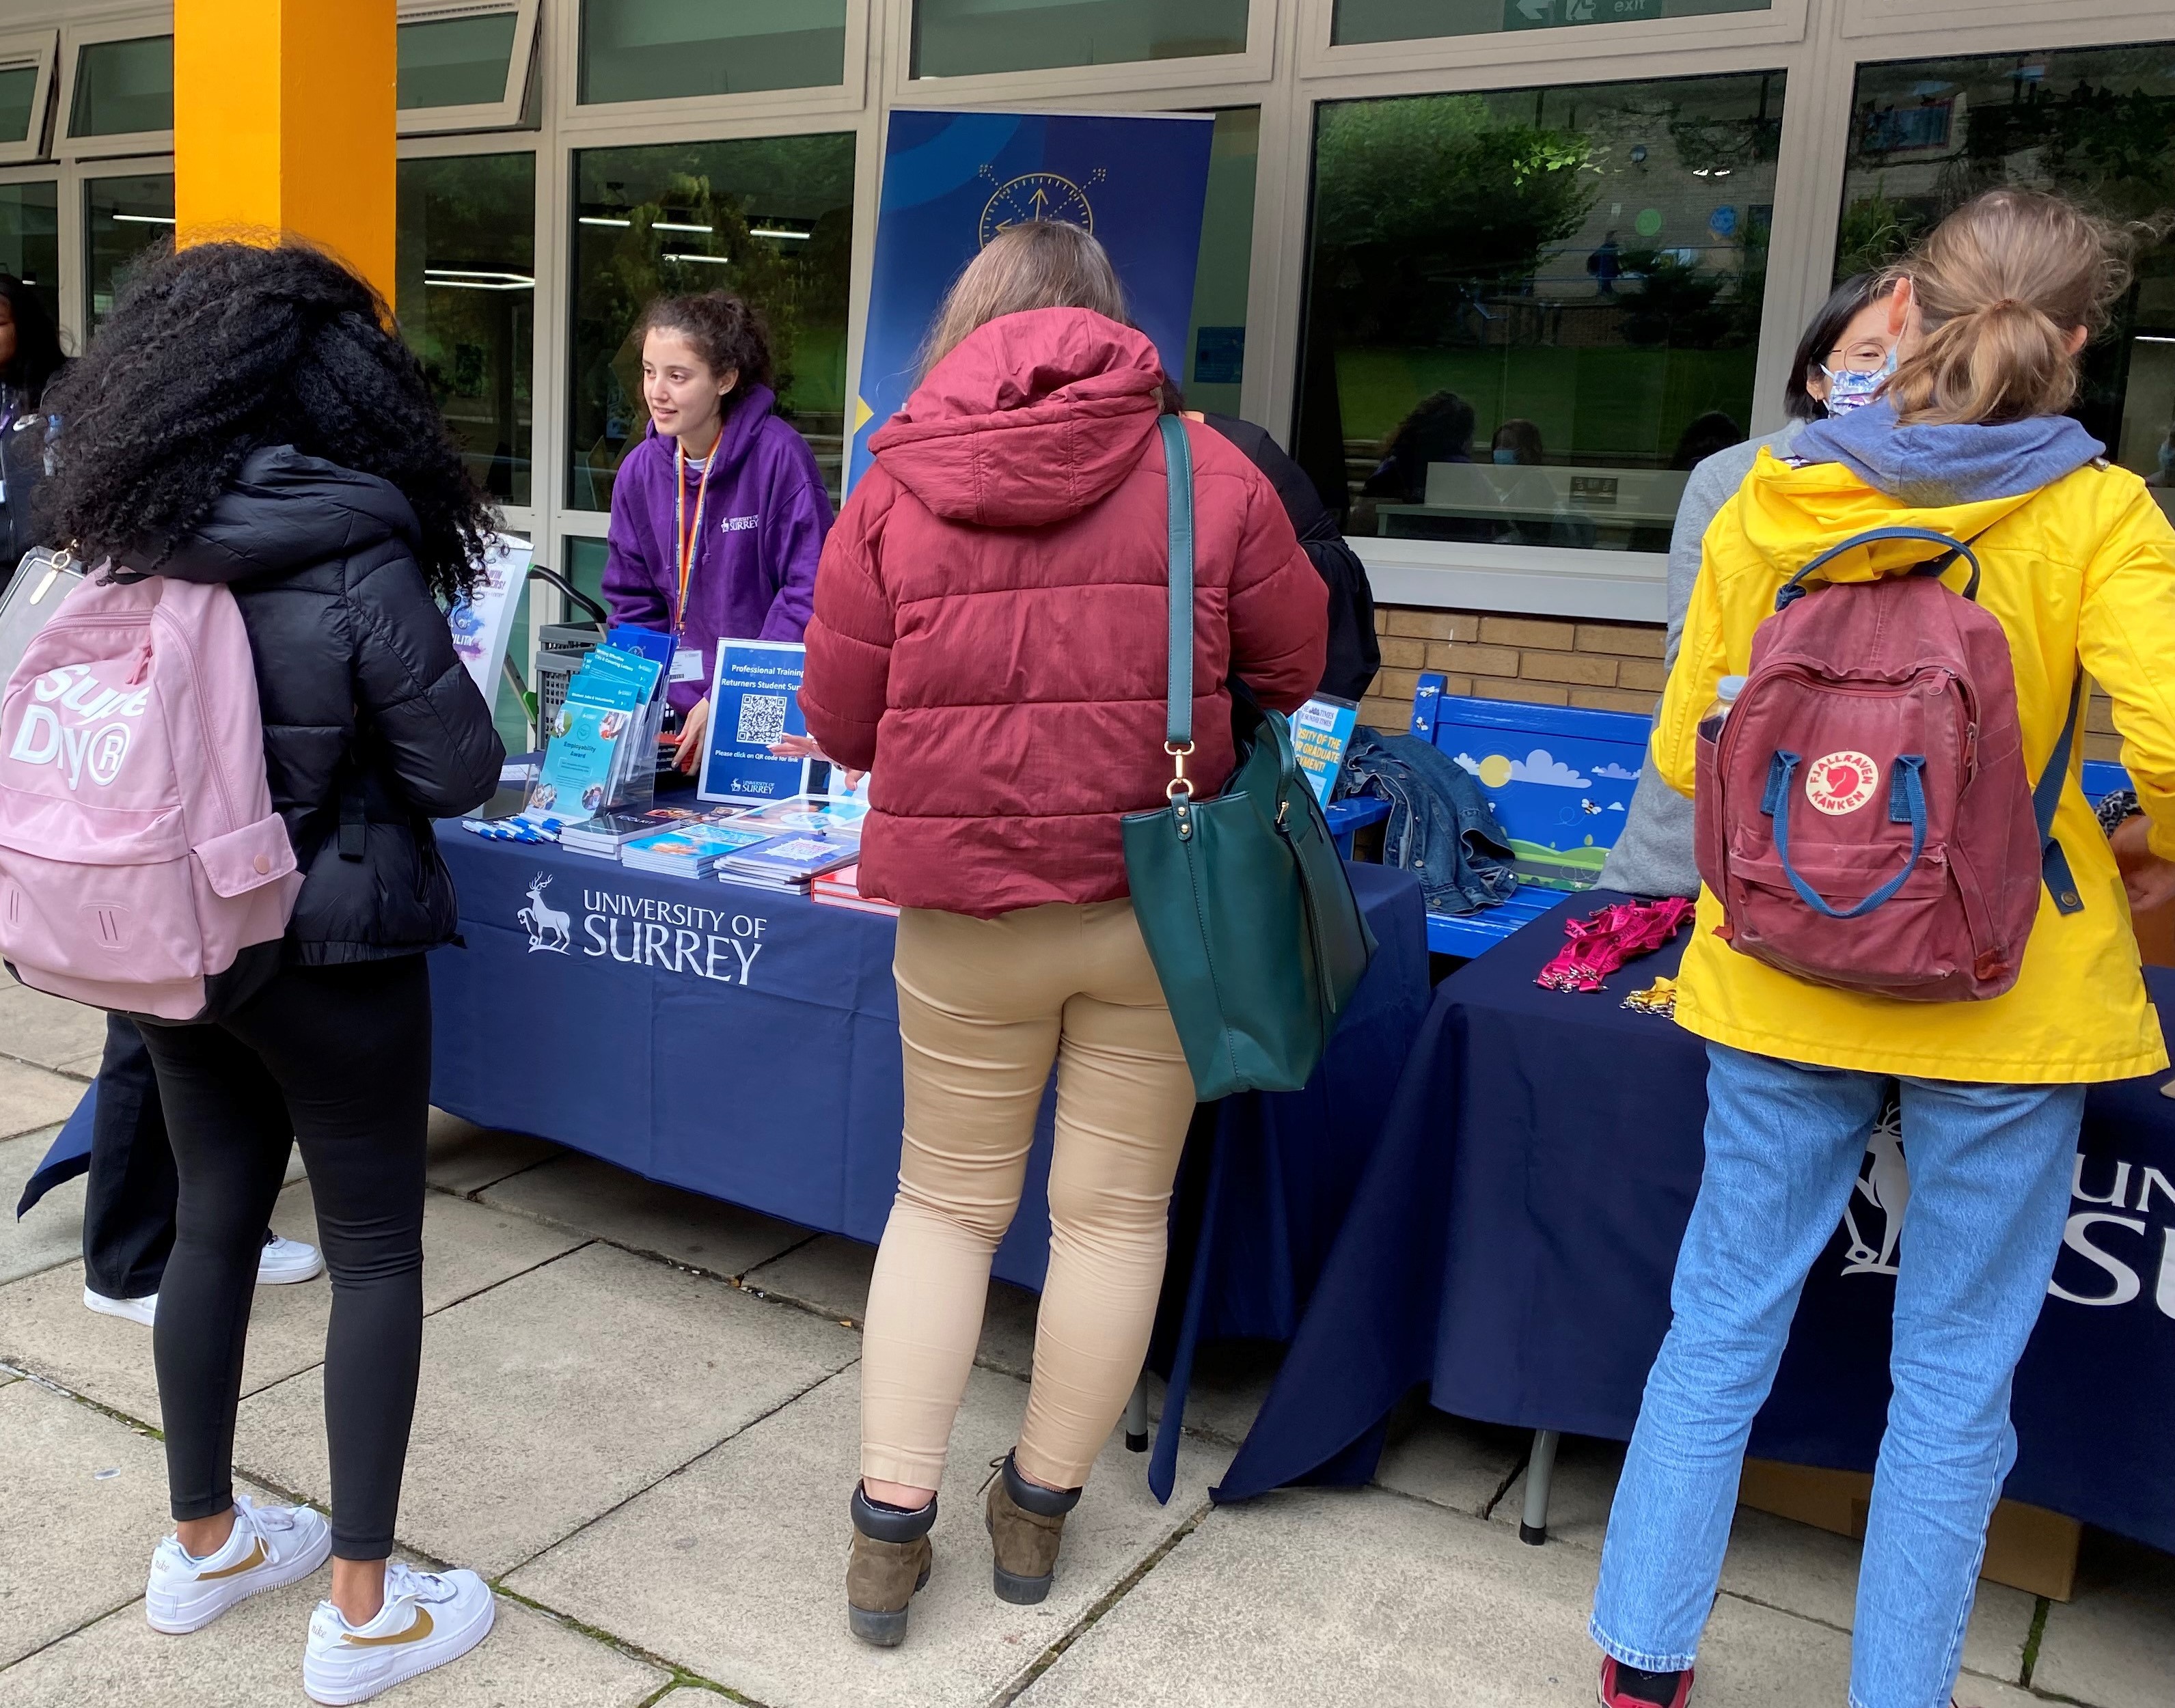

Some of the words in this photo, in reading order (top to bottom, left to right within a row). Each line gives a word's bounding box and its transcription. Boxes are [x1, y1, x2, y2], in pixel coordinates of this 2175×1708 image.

[729, 519, 759, 531] SURREY
[451, 633, 476, 646] ILITY
[731, 664, 775, 675] Professional
[721, 678, 756, 688] Returners
[757, 680, 786, 690] Student
[564, 741, 597, 754] Employability
[1316, 733, 1328, 745] OF
[1326, 736, 1342, 750] THE
[570, 750, 586, 759] Award
[1302, 743, 1341, 765] GRADUATE
[741, 784, 775, 795] SURREY
[583, 889, 725, 932] UNIVERSITY
[730, 914, 767, 939] OF
[582, 913, 763, 986] SURREY
[155, 1559, 170, 1573] nike
[312, 1625, 327, 1638] nike
